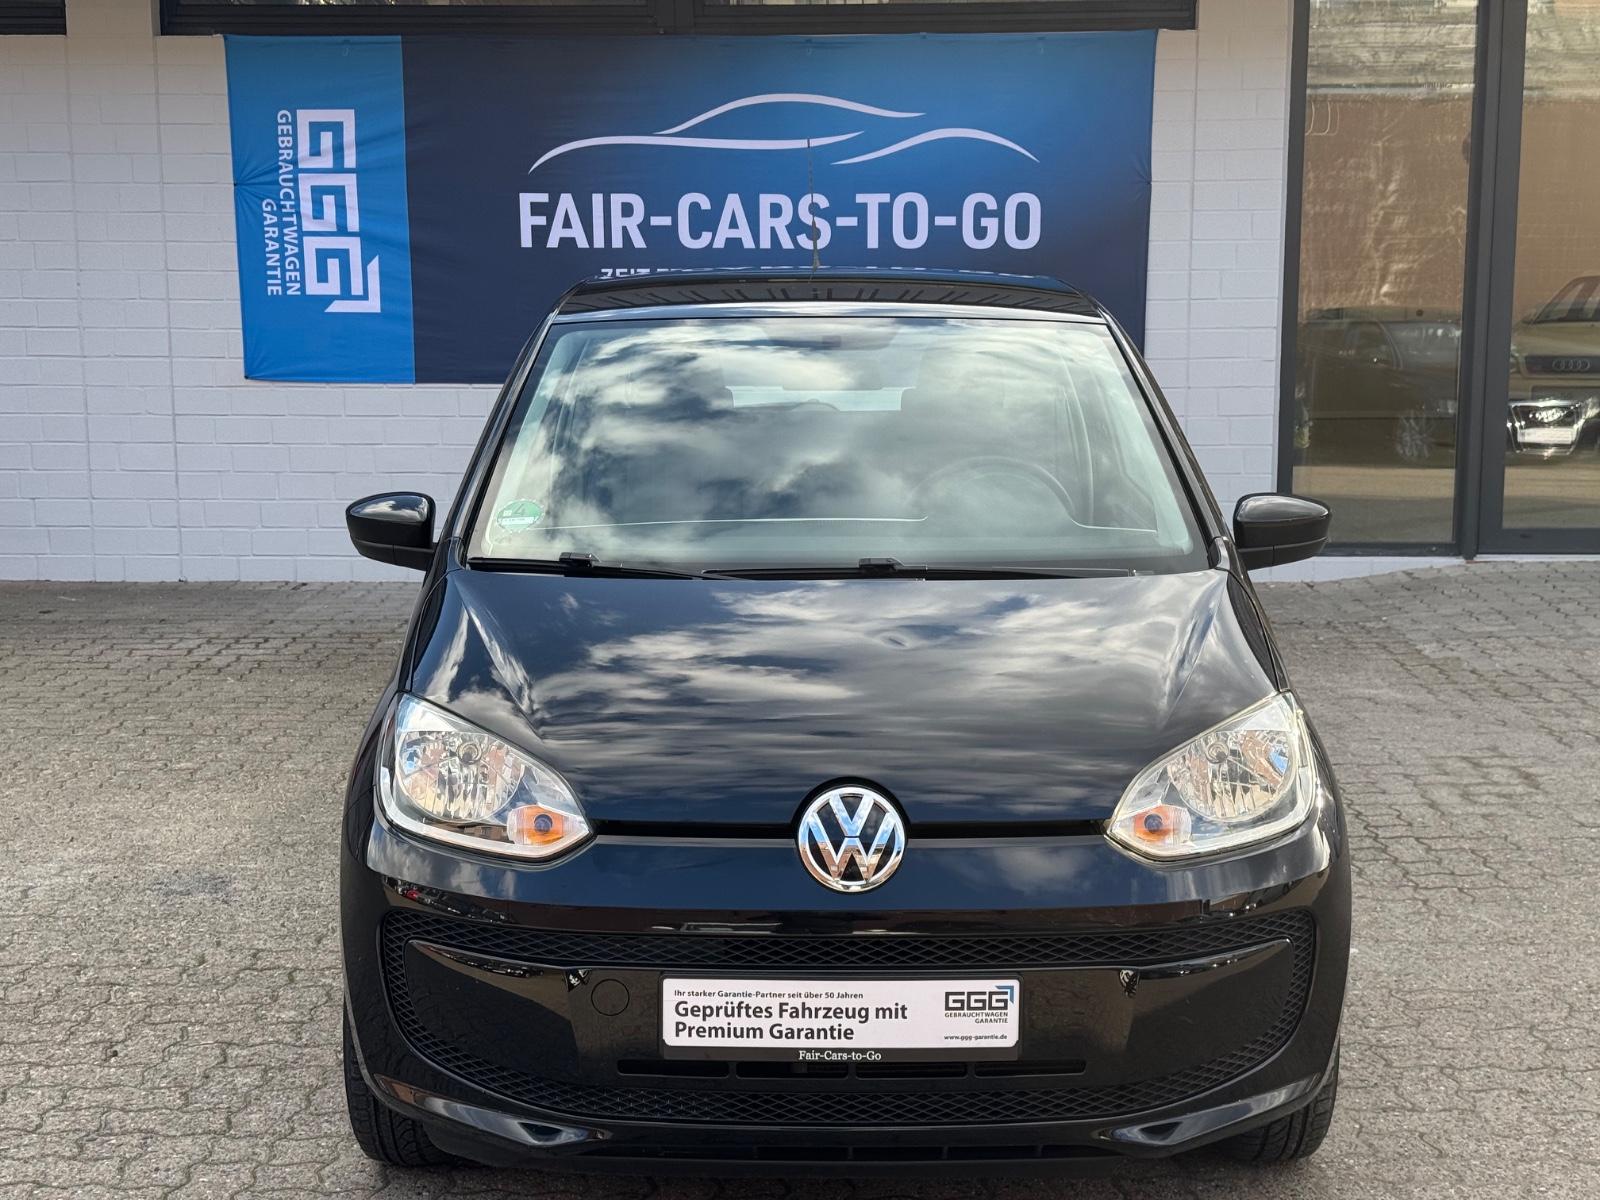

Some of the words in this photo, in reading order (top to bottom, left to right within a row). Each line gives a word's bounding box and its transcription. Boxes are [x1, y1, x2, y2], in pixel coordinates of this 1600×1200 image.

[276, 109, 301, 296] GEBRAUCHTWAGEN
[518, 191, 1042, 250] FAIR-CARS-TO-GO
[261, 198, 282, 296] GARANTIE
[674, 989, 686, 997] Ihr
[687, 990, 716, 998] starker
[717, 990, 786, 999] Garantie-Partner
[787, 991, 802, 999] seit
[804, 991, 823, 999] über
[836, 992, 864, 1000] Jahren
[945, 991, 1009, 1011] GGG
[674, 1000, 773, 1022] Geprüftes
[779, 1001, 869, 1024] Fahrzeug
[875, 1002, 908, 1020] mit
[675, 1021, 764, 1040] Premium
[769, 1023, 855, 1041] Garantie
[798, 1050, 882, 1061] Fair-Cars-to-Go
